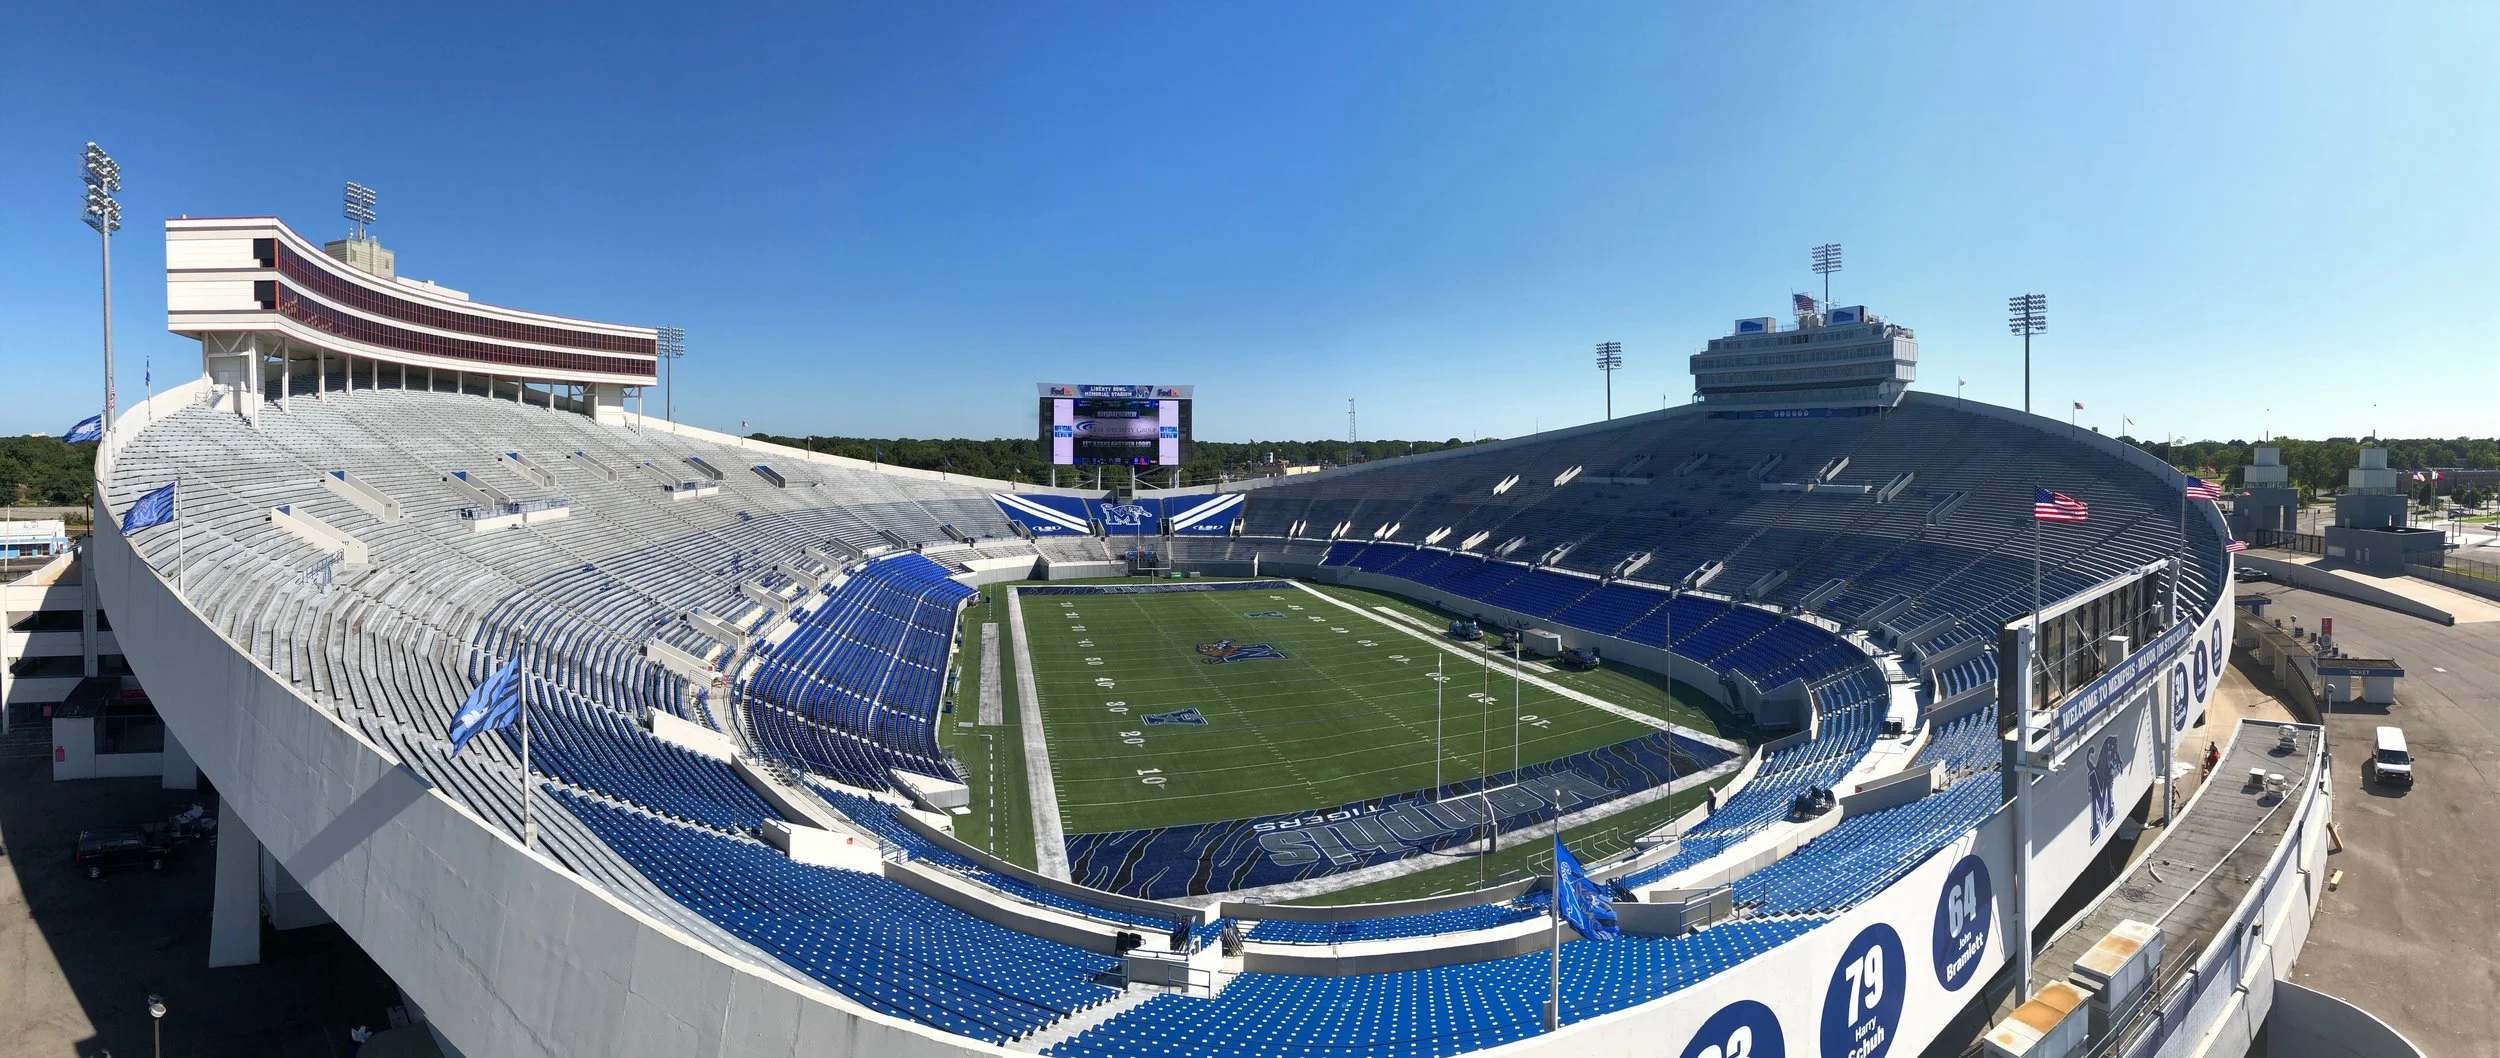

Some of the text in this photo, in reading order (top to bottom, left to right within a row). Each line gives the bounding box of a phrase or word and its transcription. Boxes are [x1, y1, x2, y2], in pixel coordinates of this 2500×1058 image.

[1051, 387, 1073, 397] FedEx
[1158, 388, 1181, 398] FedEx
[2062, 690, 2099, 731] WELCOME
[2099, 684, 2108, 701] TO
[2108, 662, 2136, 696] MEMPHIS
[2138, 648, 2156, 673] MAYOR
[2175, 671, 2184, 704] 30
[1106, 701, 1129, 713] 30
[1519, 714, 1552, 727] 10
[1119, 730, 1146, 745] 20
[1136, 767, 1168, 785] 10
[1253, 804, 1386, 832] TIGERS
[1948, 870, 1976, 939] 64
[1959, 931, 1972, 951] John
[1946, 931, 1984, 983] Bramlett
[1845, 944, 1884, 1028] 79
[1855, 1015, 1877, 1043] Harry
